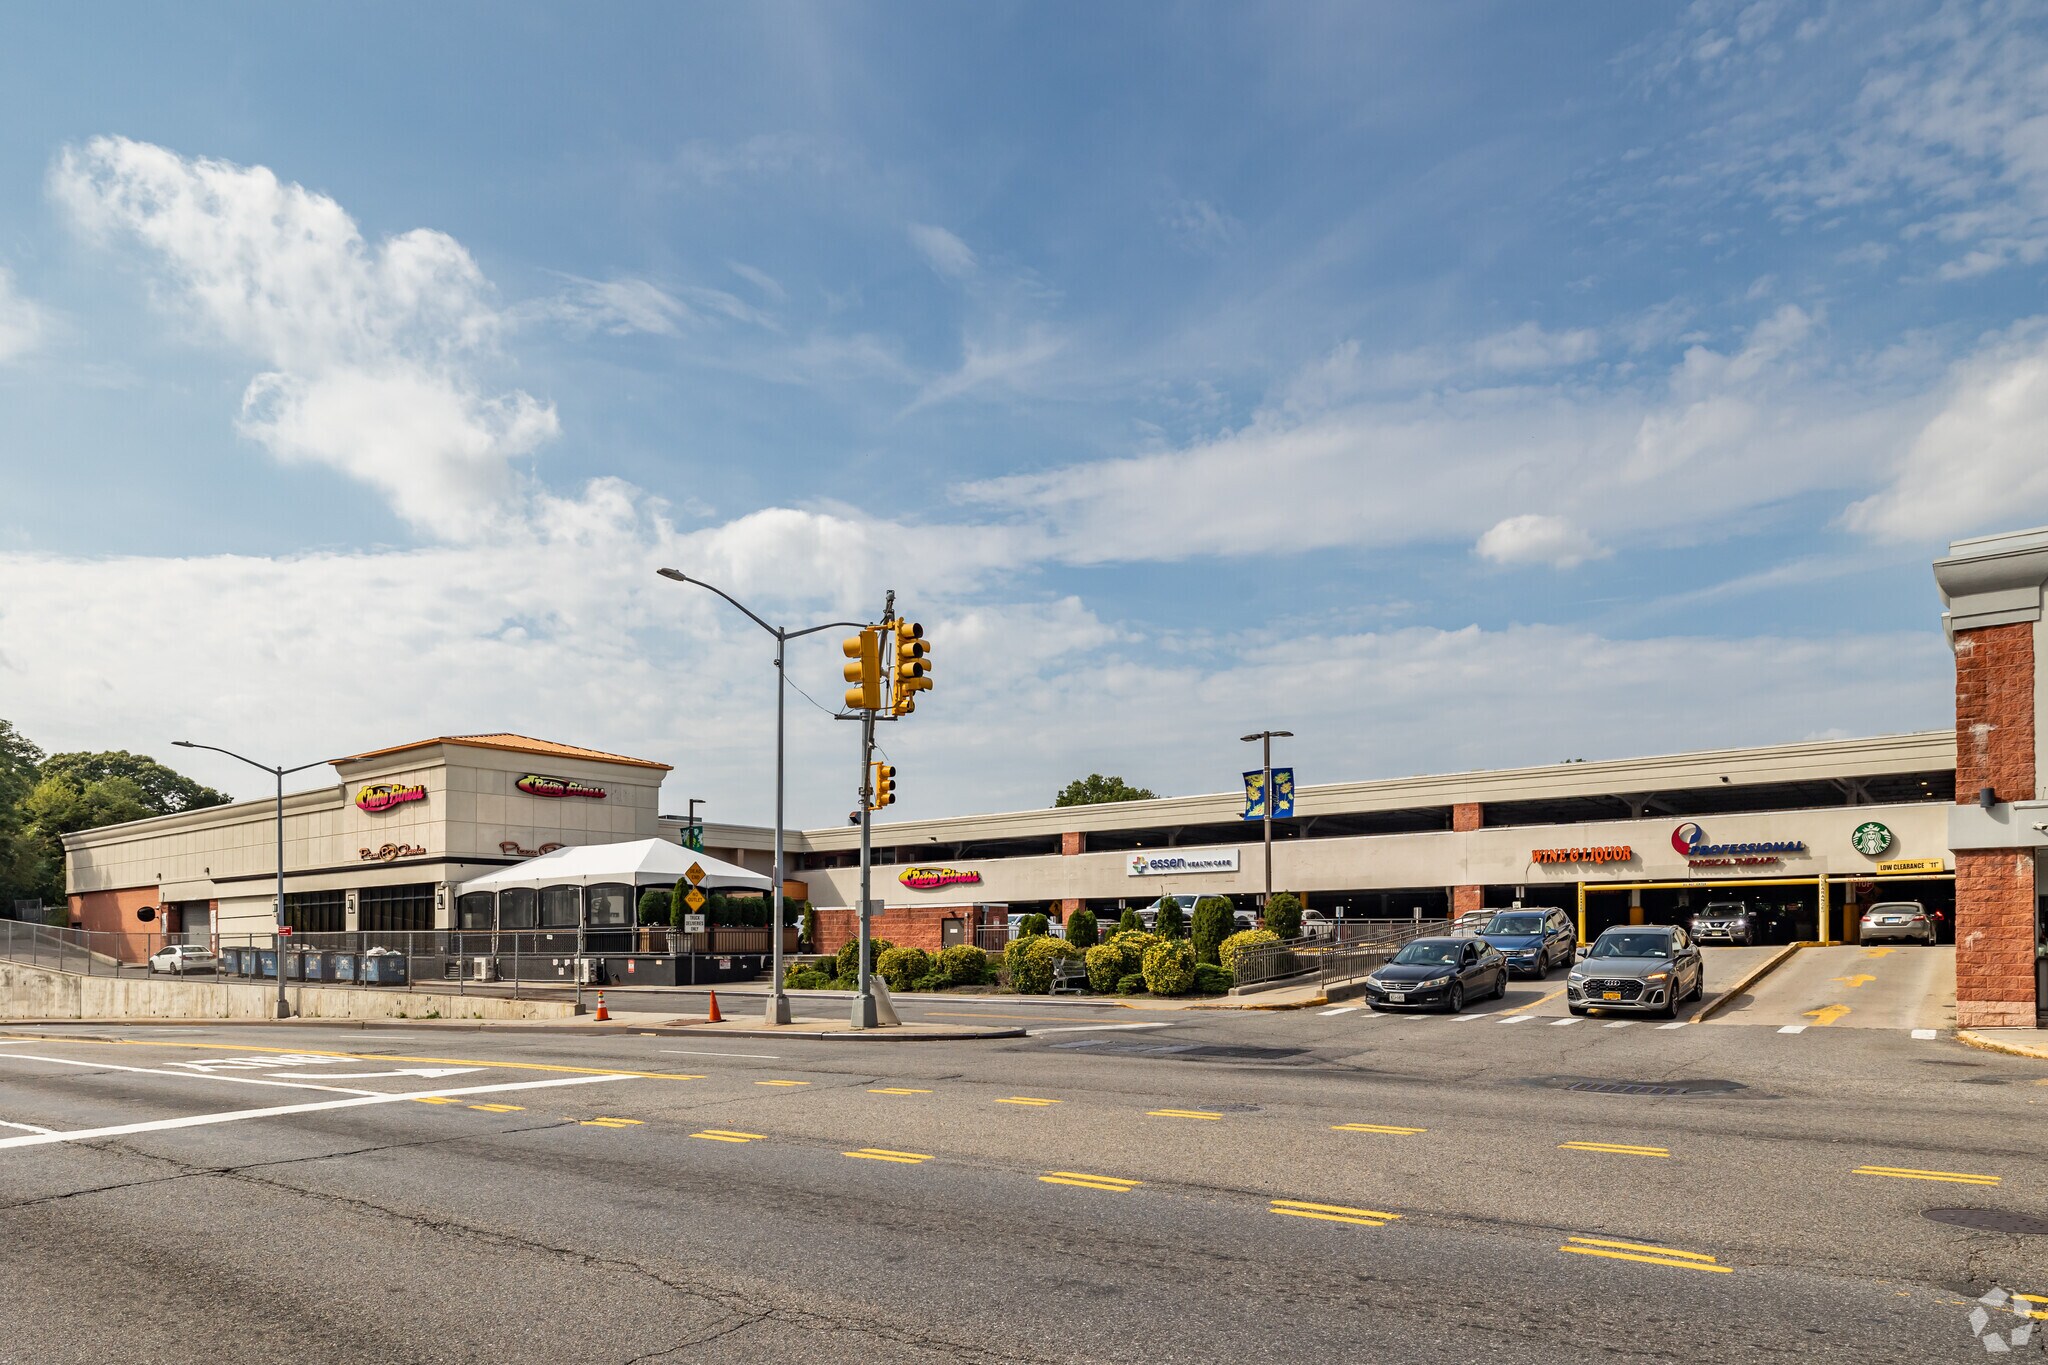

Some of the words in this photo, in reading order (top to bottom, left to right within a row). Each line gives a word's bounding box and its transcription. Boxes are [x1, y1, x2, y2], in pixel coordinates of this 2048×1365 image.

[365, 788, 389, 808] Retro
[389, 784, 424, 803] Fitness
[534, 778, 564, 794] Retro
[566, 782, 607, 798] Fitness
[1532, 848, 1568, 864] WINE
[1569, 848, 1579, 862] &
[1582, 845, 1631, 865] LIQUOR
[1689, 841, 1805, 856] PROFESSIONAL
[1150, 858, 1185, 869] essen
[1688, 858, 1733, 867] PHYSICAL
[1734, 856, 1778, 866] THERAPY
[1893, 862, 1924, 870] CLEARANCE
[910, 869, 938, 885] Retro
[939, 867, 980, 884] Fitness
